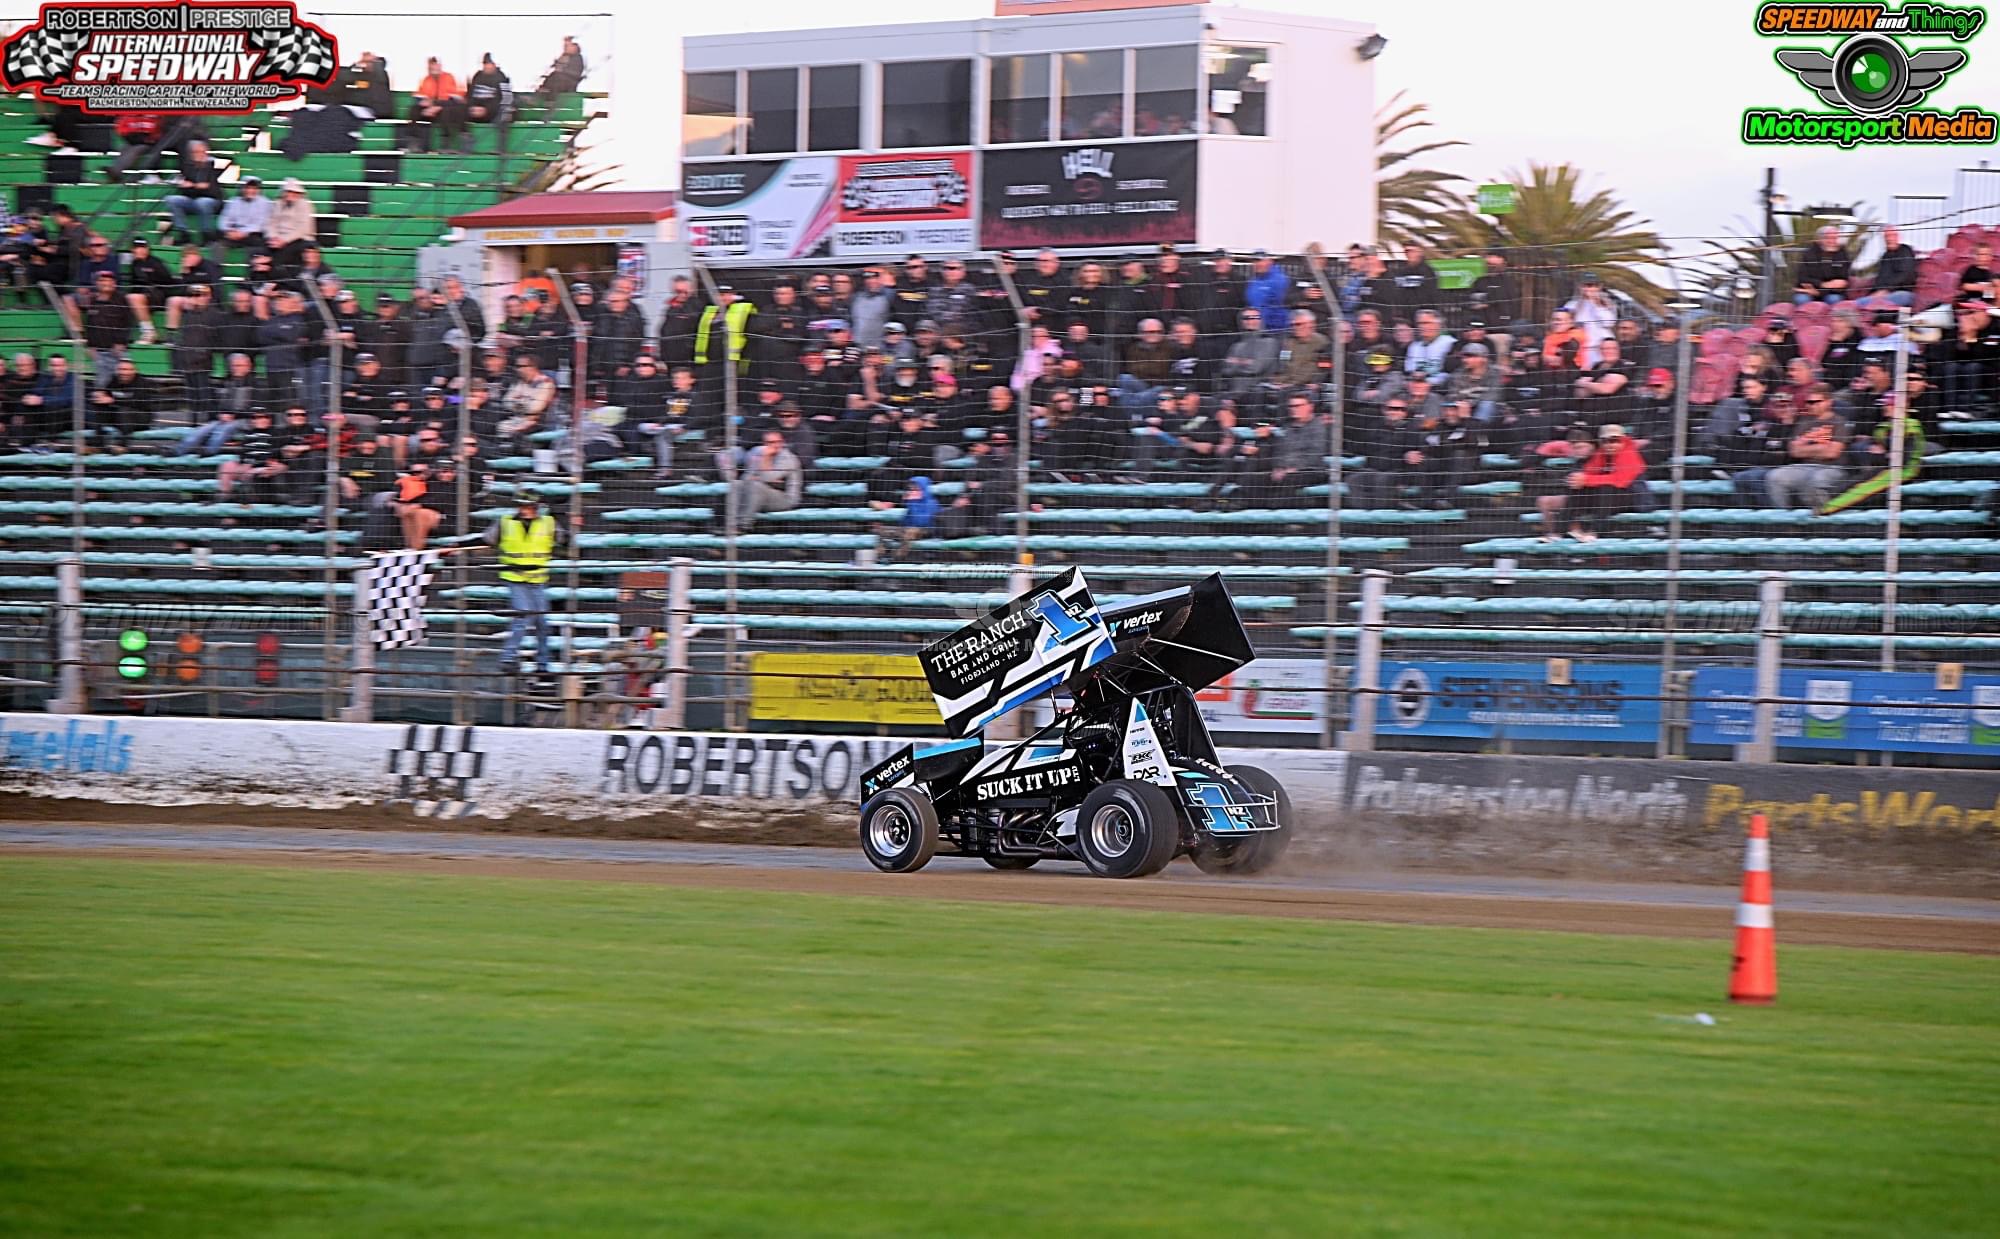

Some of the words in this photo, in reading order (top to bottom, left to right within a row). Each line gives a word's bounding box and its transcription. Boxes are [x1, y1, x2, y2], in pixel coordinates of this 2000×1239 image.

[1062, 148, 1114, 180] HELL
[1123, 610, 1163, 630] vertex
[931, 641, 967, 673] THE
[965, 611, 1027, 655] RANCH
[950, 664, 970, 679] BAR
[972, 652, 990, 668] AND
[992, 637, 1020, 656] GRILL
[876, 755, 910, 781] vertex
[977, 776, 1024, 800] SUCK
[1024, 773, 1043, 791] IT
[1047, 767, 1072, 786] UP
[1071, 765, 1081, 782] LTD
[1704, 784, 2000, 832] PartsWor
